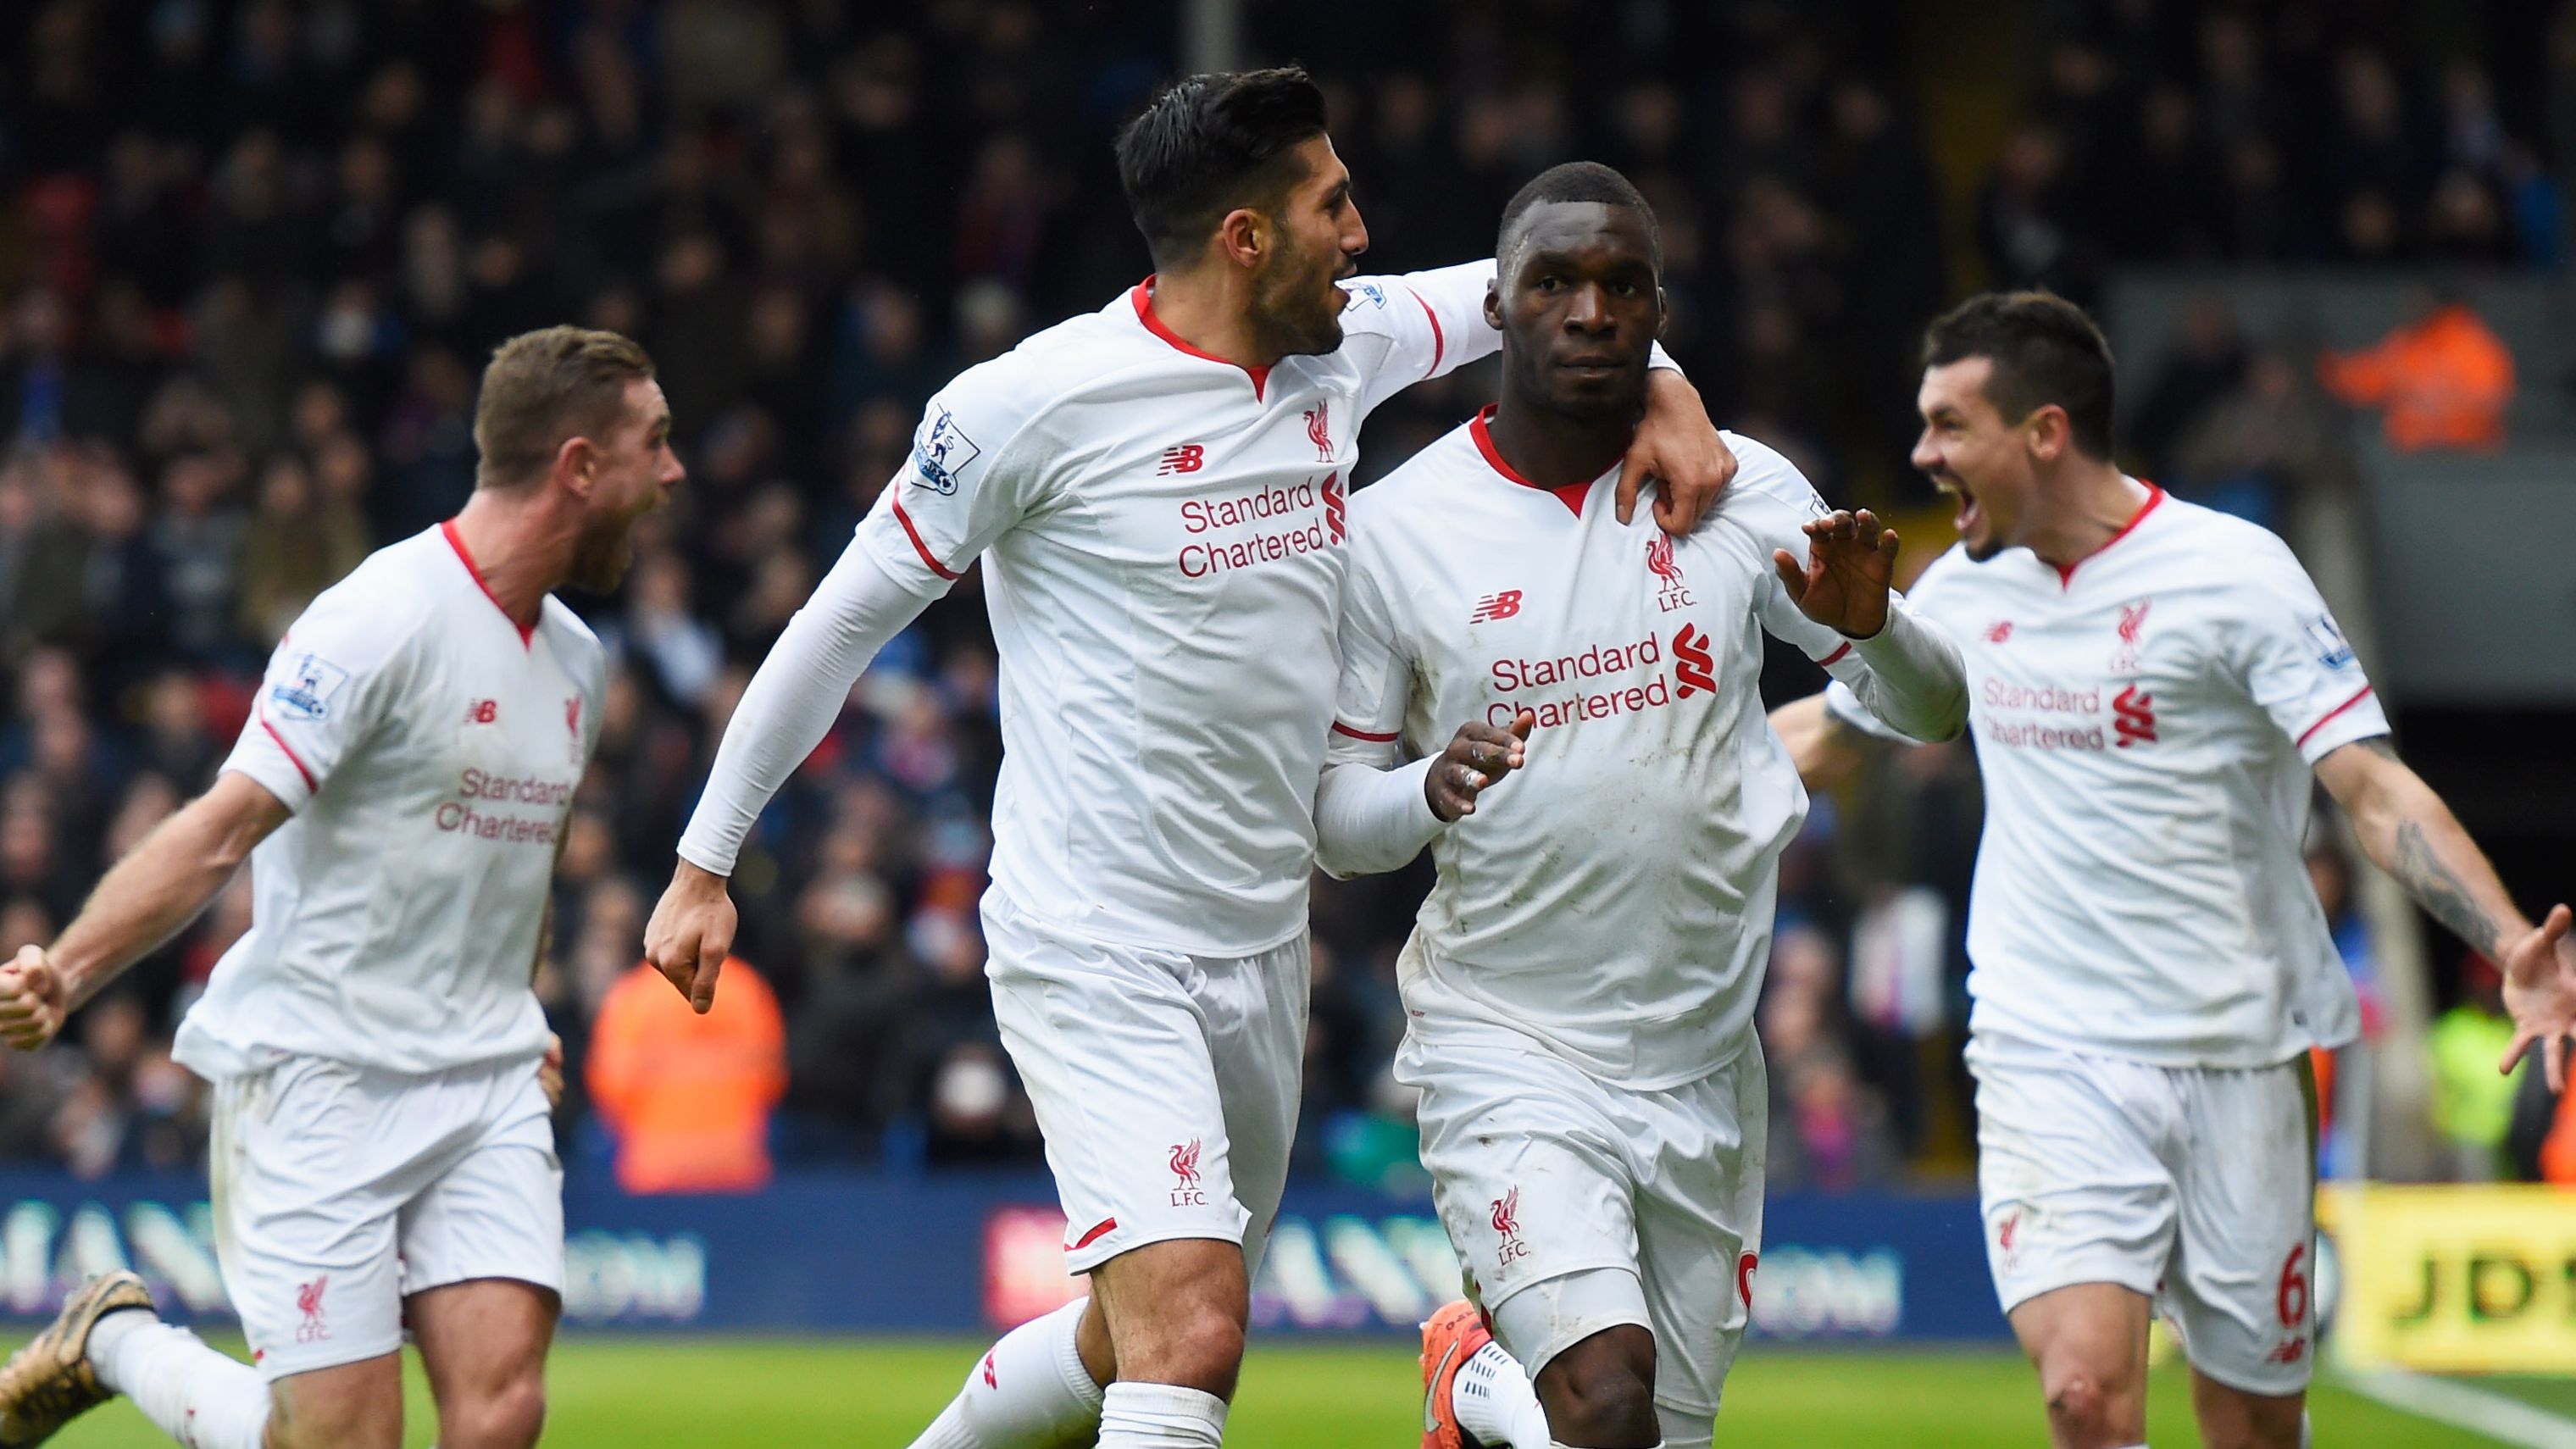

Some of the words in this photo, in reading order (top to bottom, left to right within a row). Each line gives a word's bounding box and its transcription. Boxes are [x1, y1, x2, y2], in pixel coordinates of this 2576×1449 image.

[1181, 476, 1314, 533] Standard
[1179, 518, 1324, 577] Chartered
[1491, 631, 1661, 691] Standard
[1487, 674, 1669, 729] Chartered
[1985, 678, 2101, 713] Standard
[1171, 1191, 1209, 1207] L.F.C.
[1498, 1241, 1531, 1266] L.F.C.
[2277, 1242, 2307, 1329] 6
[2391, 1256, 2576, 1324] JD
